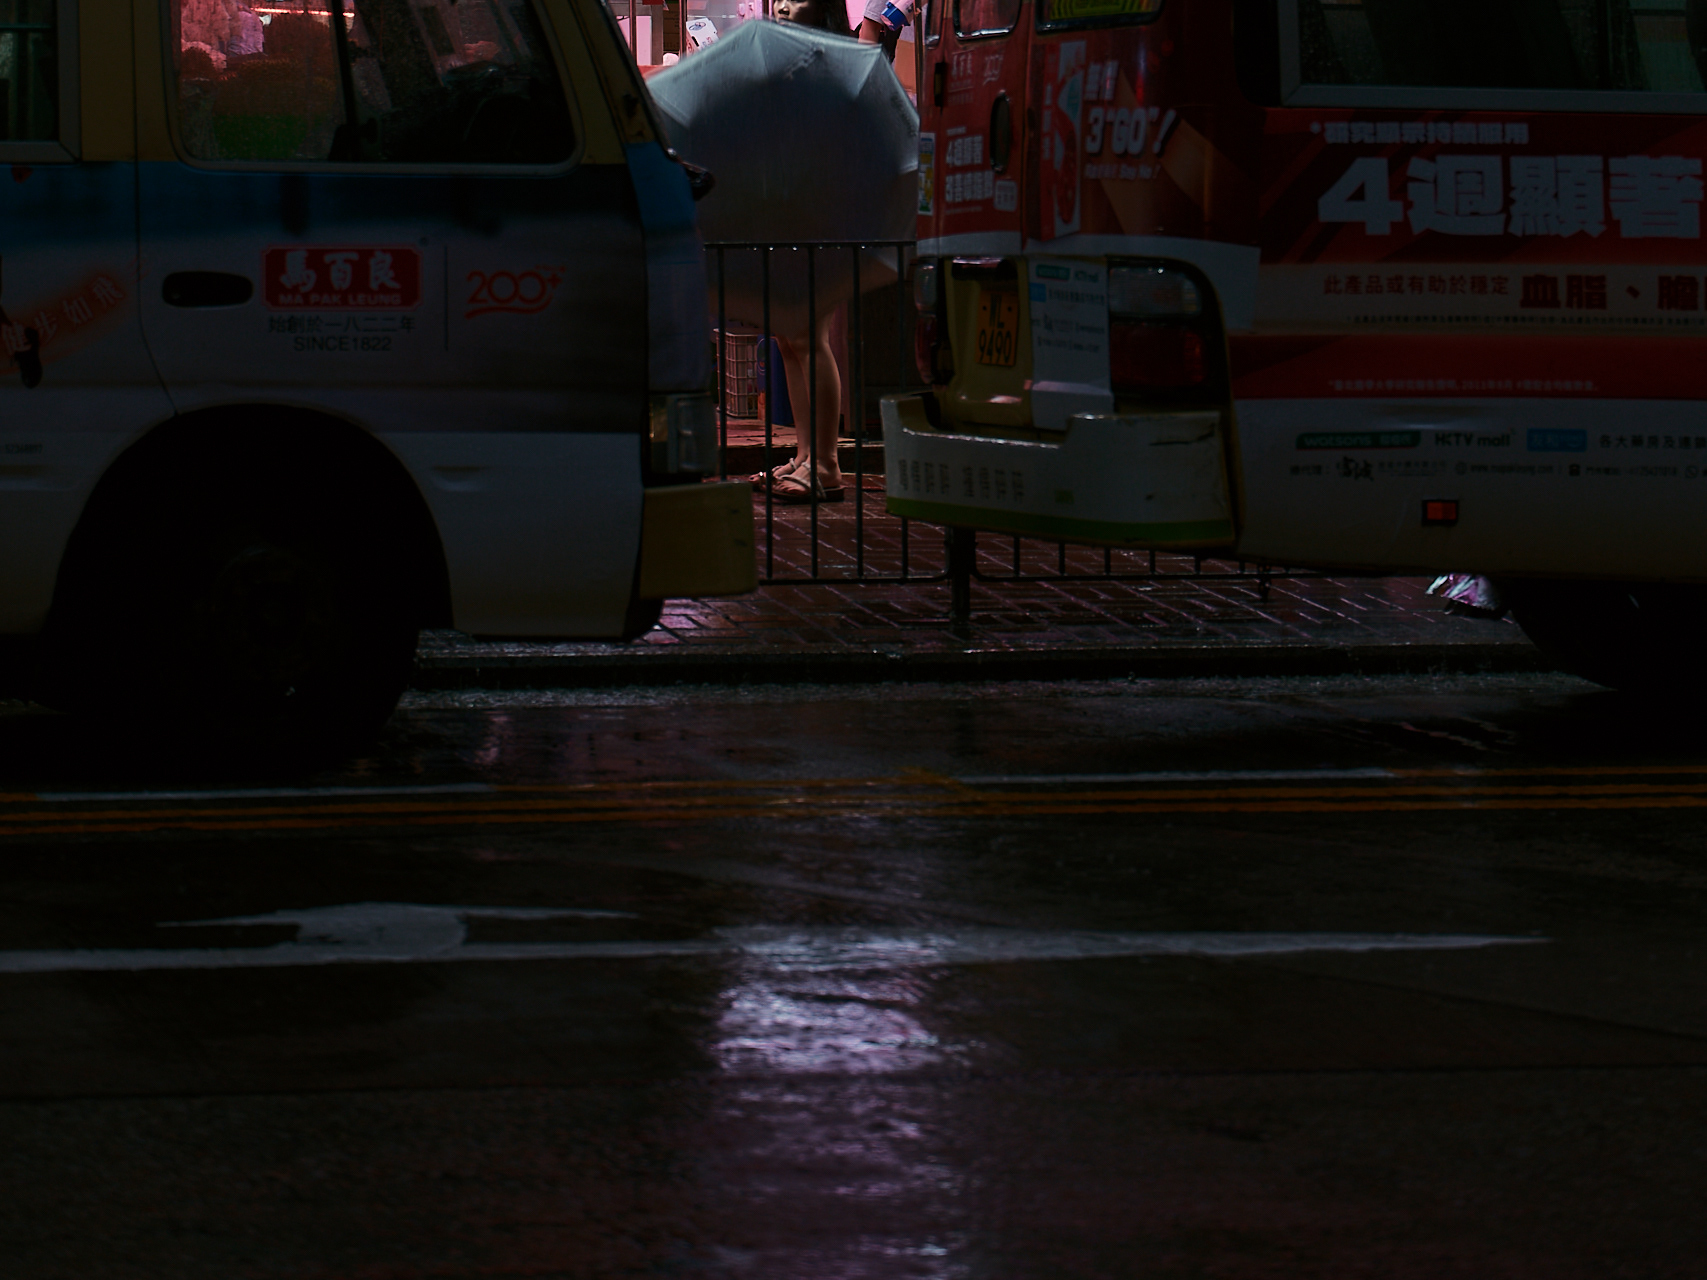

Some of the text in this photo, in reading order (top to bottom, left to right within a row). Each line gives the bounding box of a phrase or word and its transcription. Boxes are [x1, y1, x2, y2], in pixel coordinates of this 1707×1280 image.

[1317, 154, 1705, 239] 4週顯著
[278, 250, 403, 293] 馬百良
[278, 293, 402, 306] MA PAK LEUNG
[268, 315, 415, 334] 始創於一八二二年
[978, 328, 1012, 364] 9490
[1304, 433, 1372, 448] watsons
